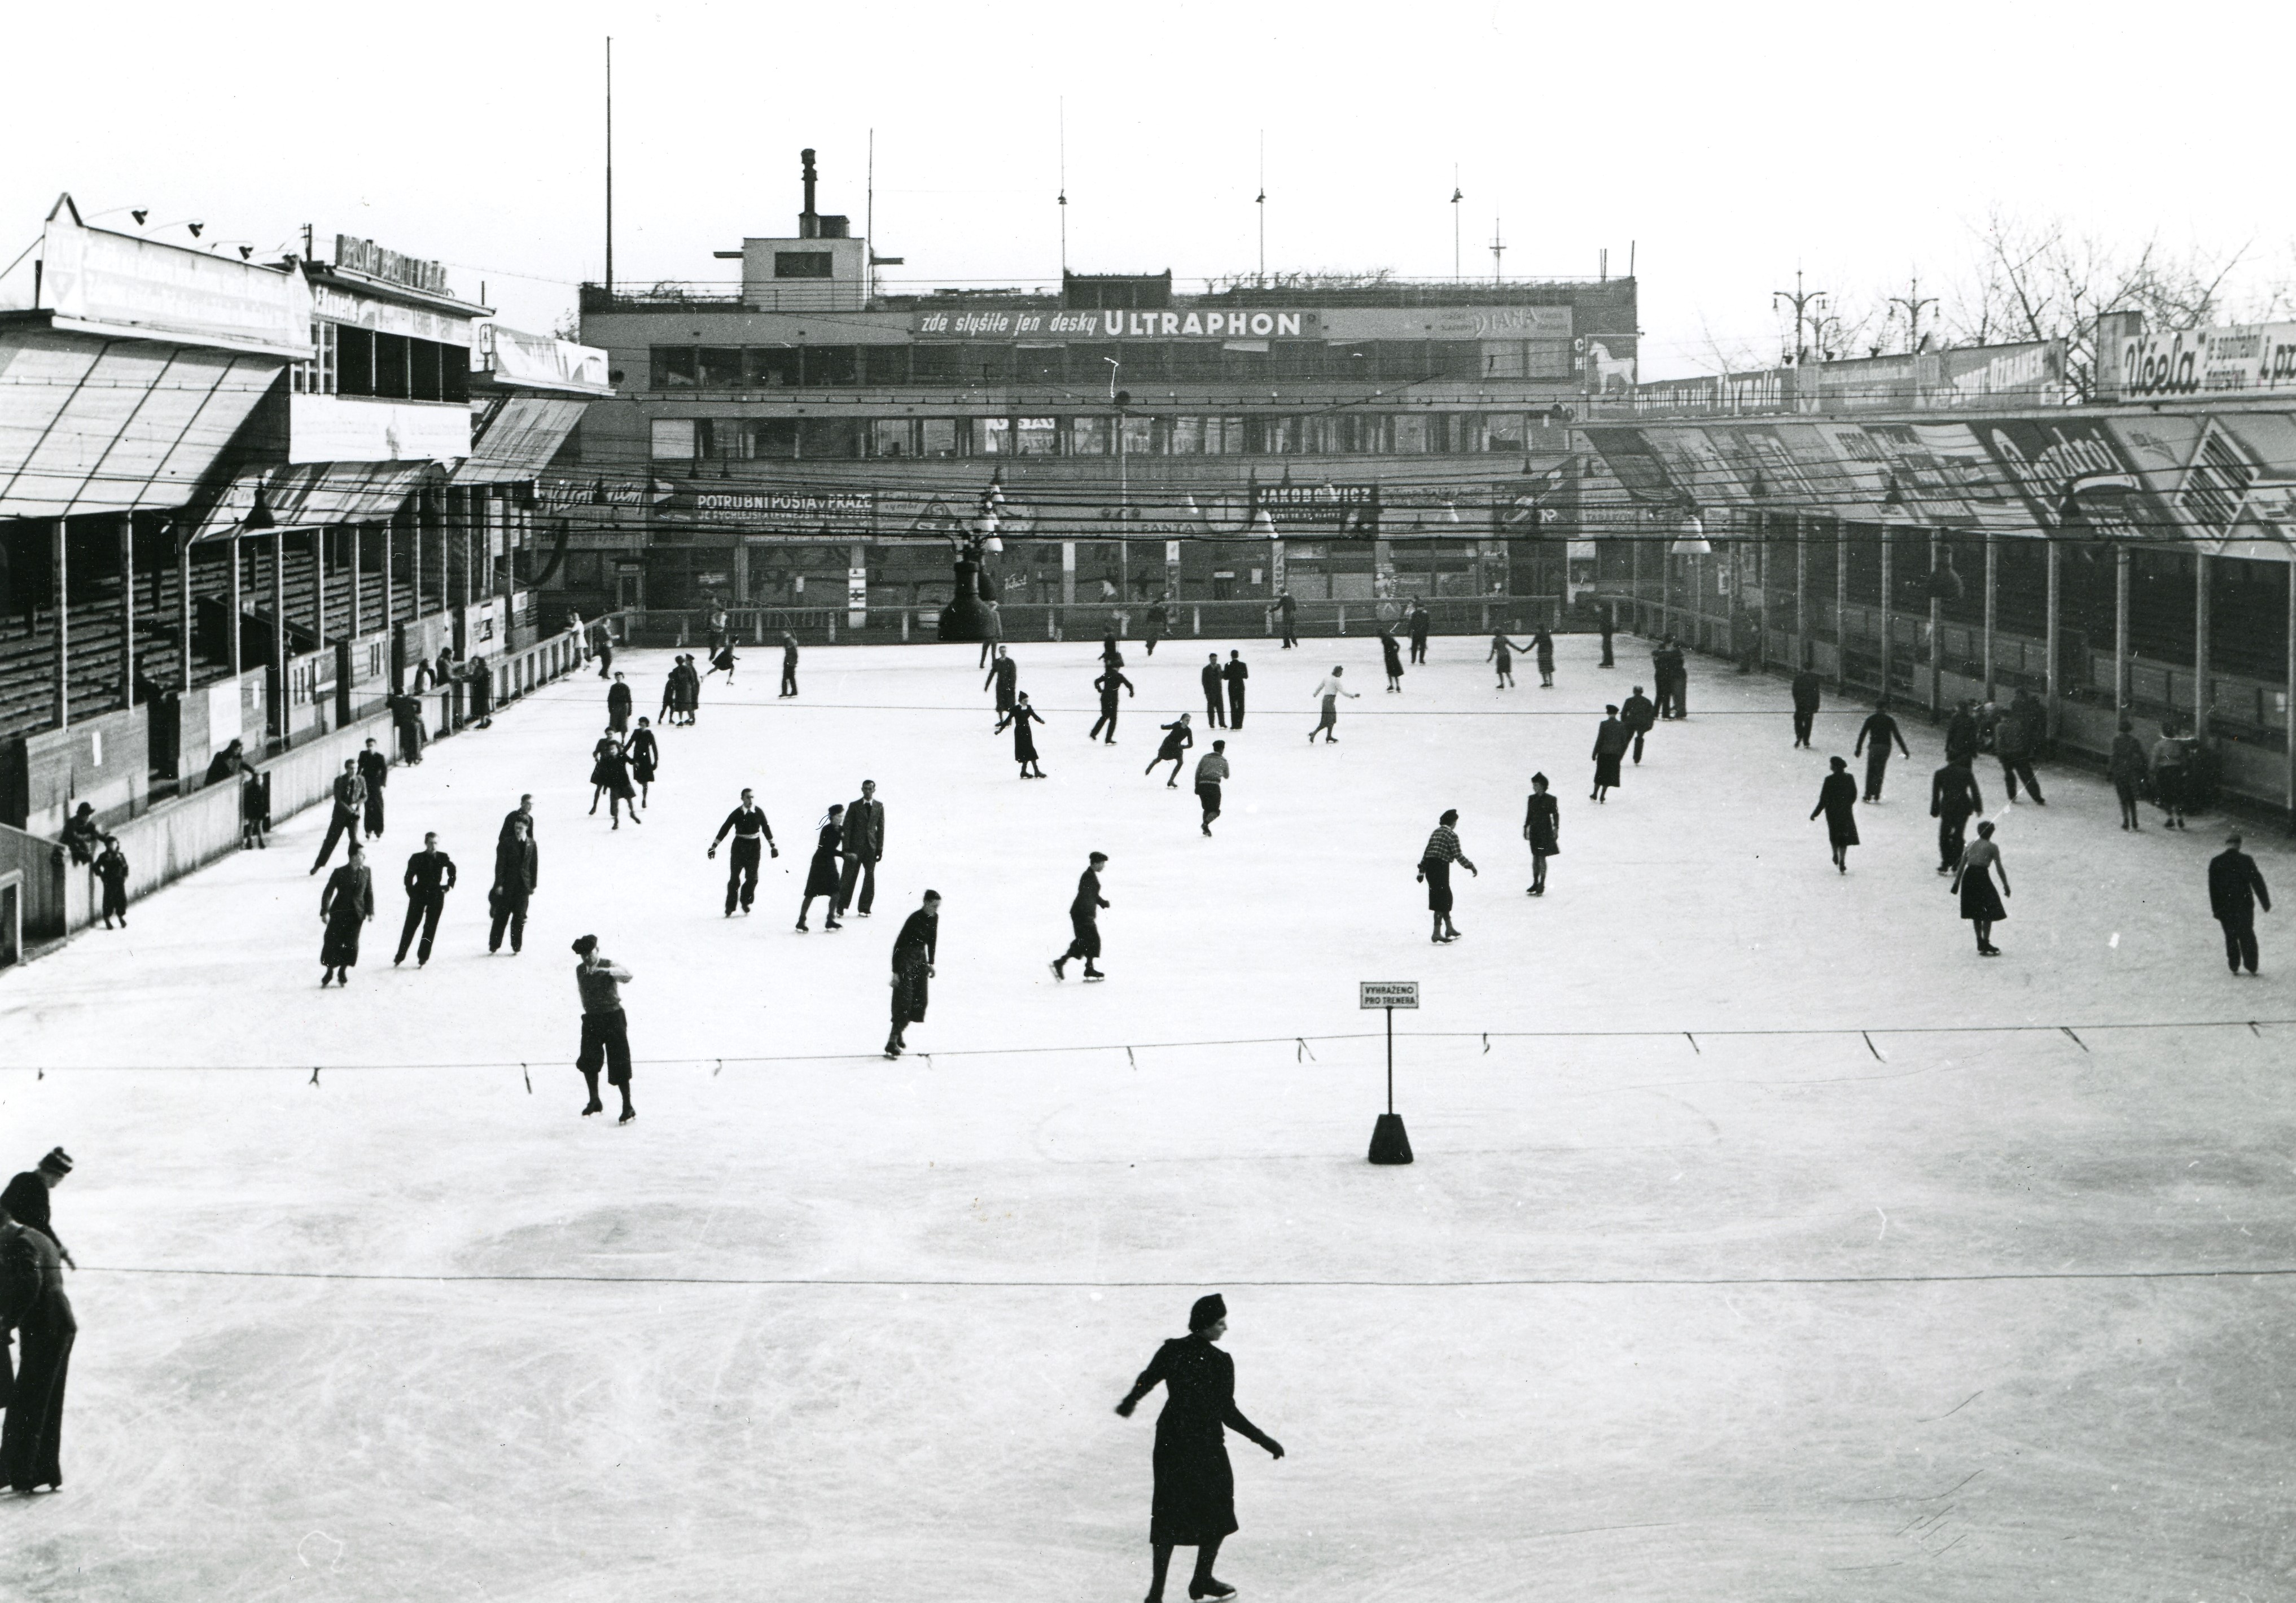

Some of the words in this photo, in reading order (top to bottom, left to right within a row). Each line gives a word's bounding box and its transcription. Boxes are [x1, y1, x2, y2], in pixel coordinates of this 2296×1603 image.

[922, 313, 948, 332] zde
[1013, 313, 1041, 337] jen
[1050, 313, 1097, 336] desky
[1105, 310, 1300, 335] ULTRAPHON
